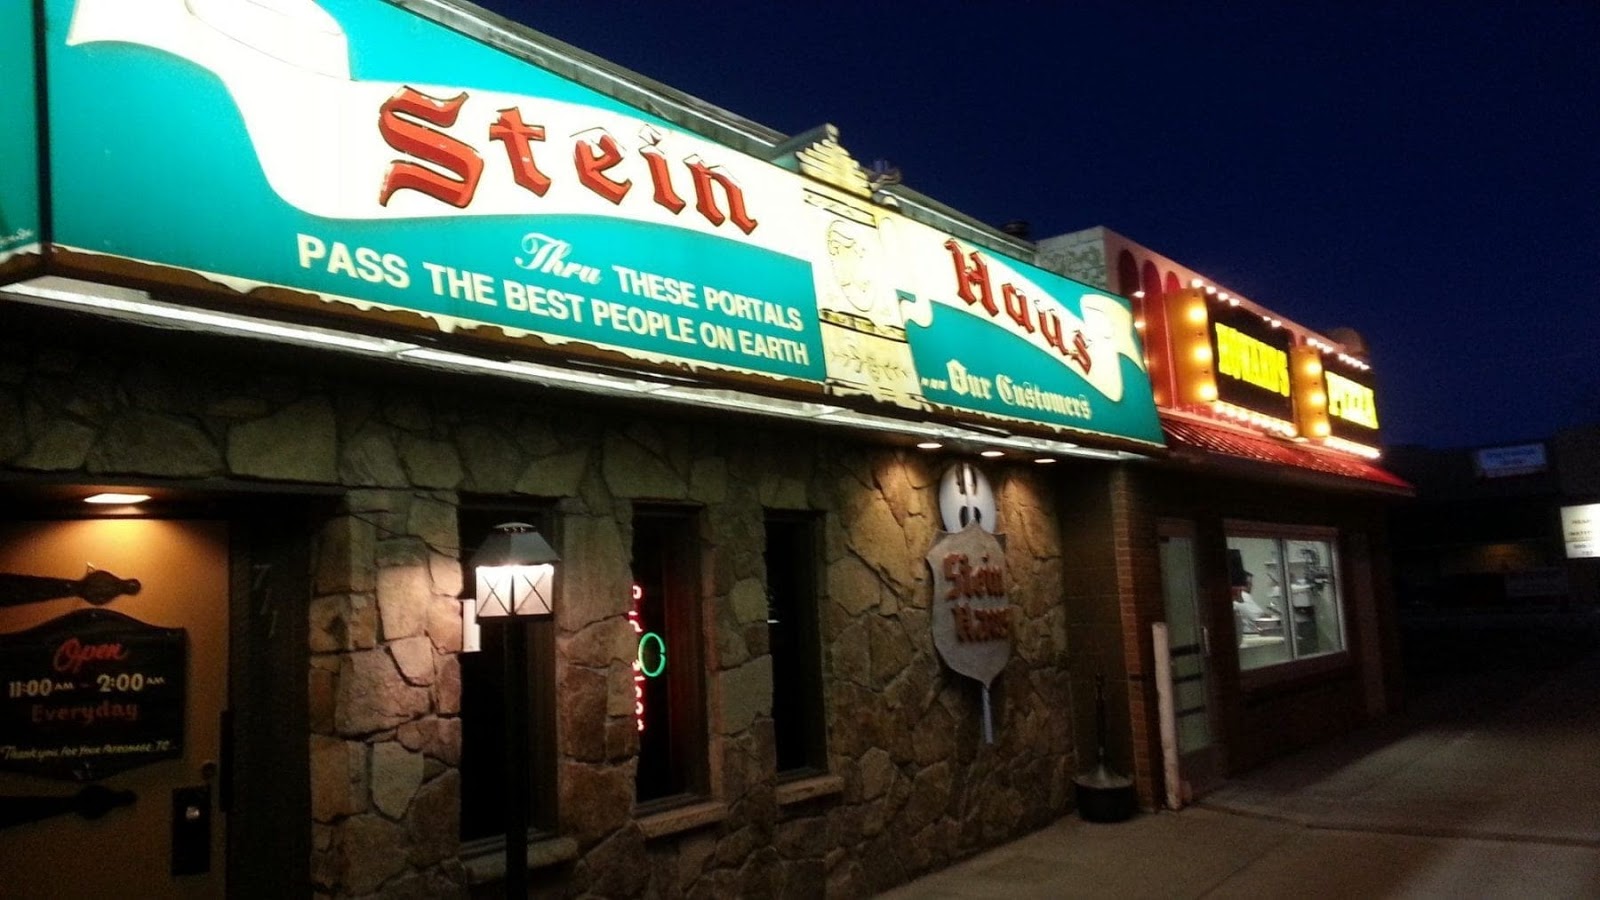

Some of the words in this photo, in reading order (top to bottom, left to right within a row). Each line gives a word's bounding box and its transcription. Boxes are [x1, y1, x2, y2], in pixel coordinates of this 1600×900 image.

[378, 84, 759, 235] Stein
[296, 233, 411, 289] PASS
[422, 261, 498, 308] THE
[502, 279, 586, 324] BEST
[590, 297, 698, 345] PEOPLE
[699, 321, 737, 352] ON
[737, 329, 810, 366] EARTH
[514, 231, 602, 285] Thru
[611, 264, 700, 310] THESE
[702, 285, 806, 332] PORTALS
[944, 237, 1092, 375] Haus
[995, 373, 1092, 420] Customers
[9, 678, 51, 698] 11:00
[97, 673, 144, 693] 2:00
[31, 701, 140, 725] Everyday
